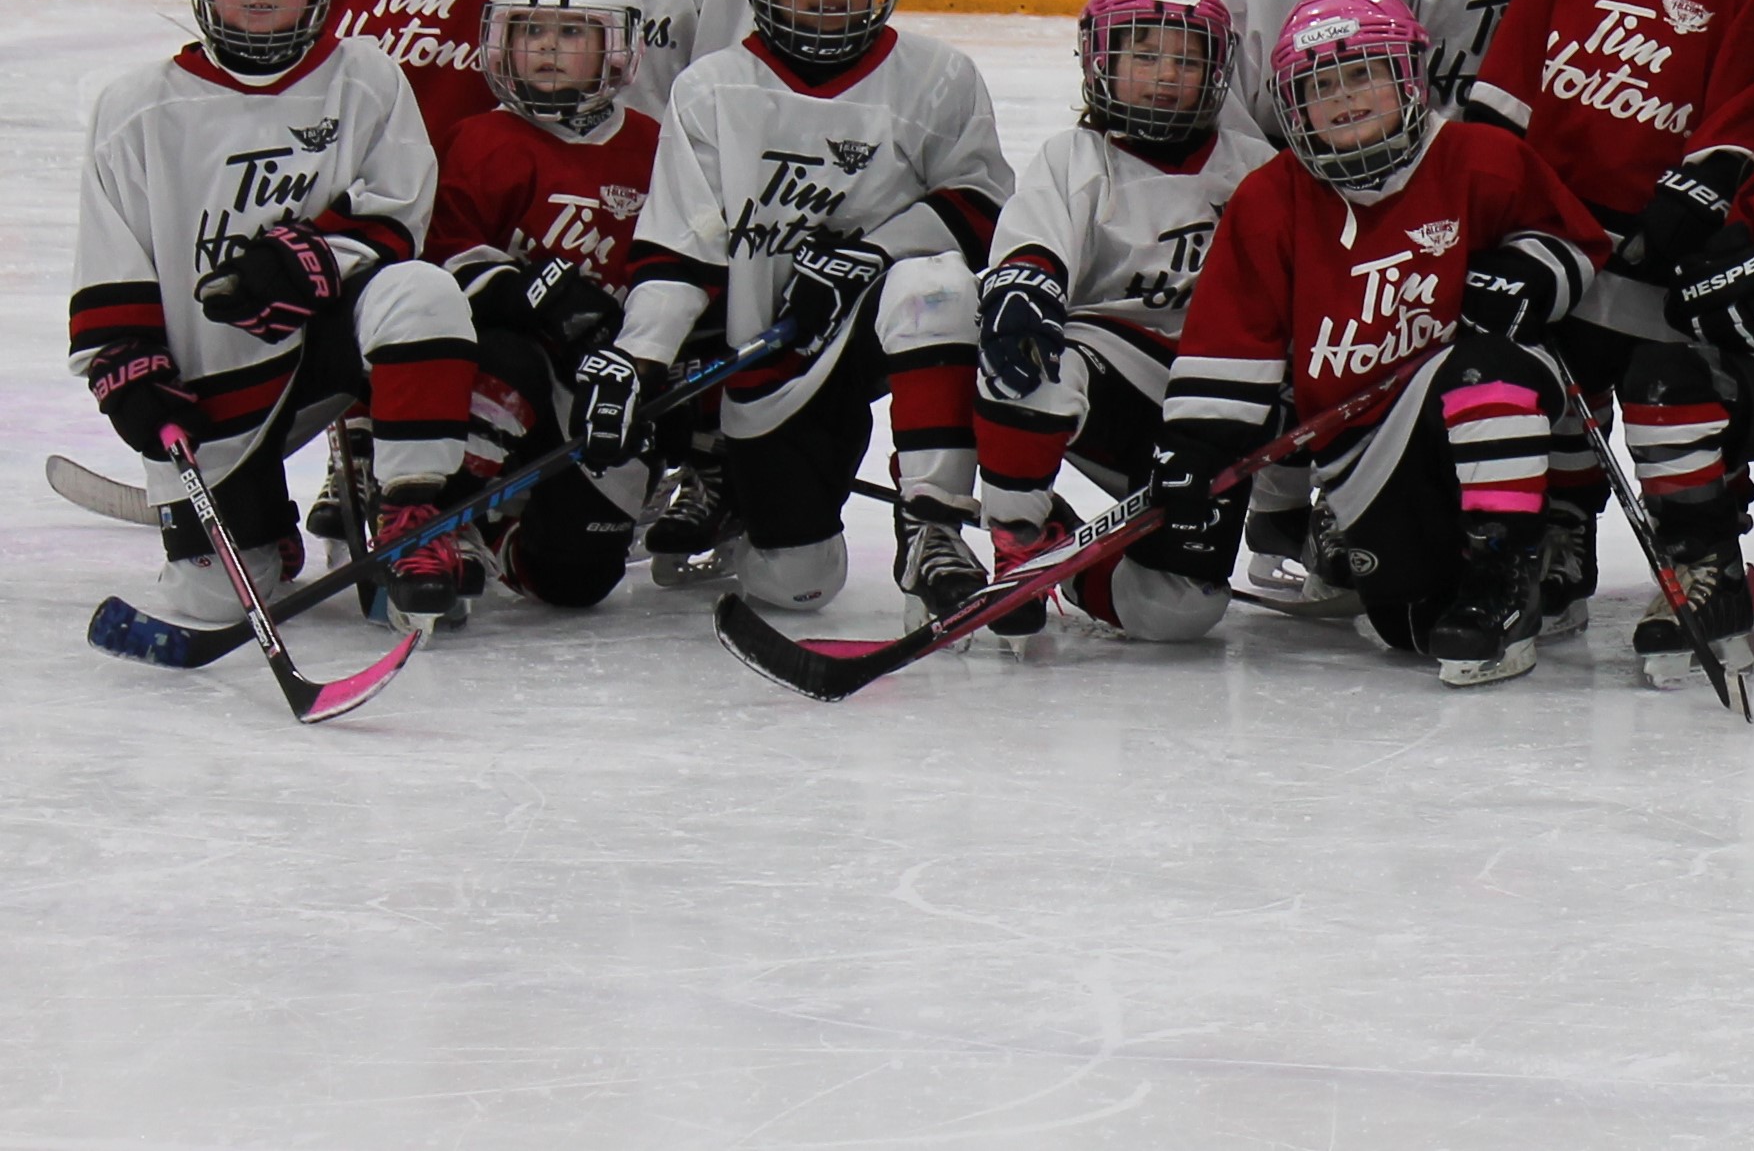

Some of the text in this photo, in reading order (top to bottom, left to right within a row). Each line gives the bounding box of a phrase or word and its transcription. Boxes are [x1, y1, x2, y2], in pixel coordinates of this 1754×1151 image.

[335, 9, 482, 71] Hrtons
[1584, 0, 1673, 74] Tim
[226, 147, 319, 214] Tim
[761, 151, 845, 217] Tim
[181, 468, 212, 523] BAUER
[1078, 487, 1152, 549] BAUER
